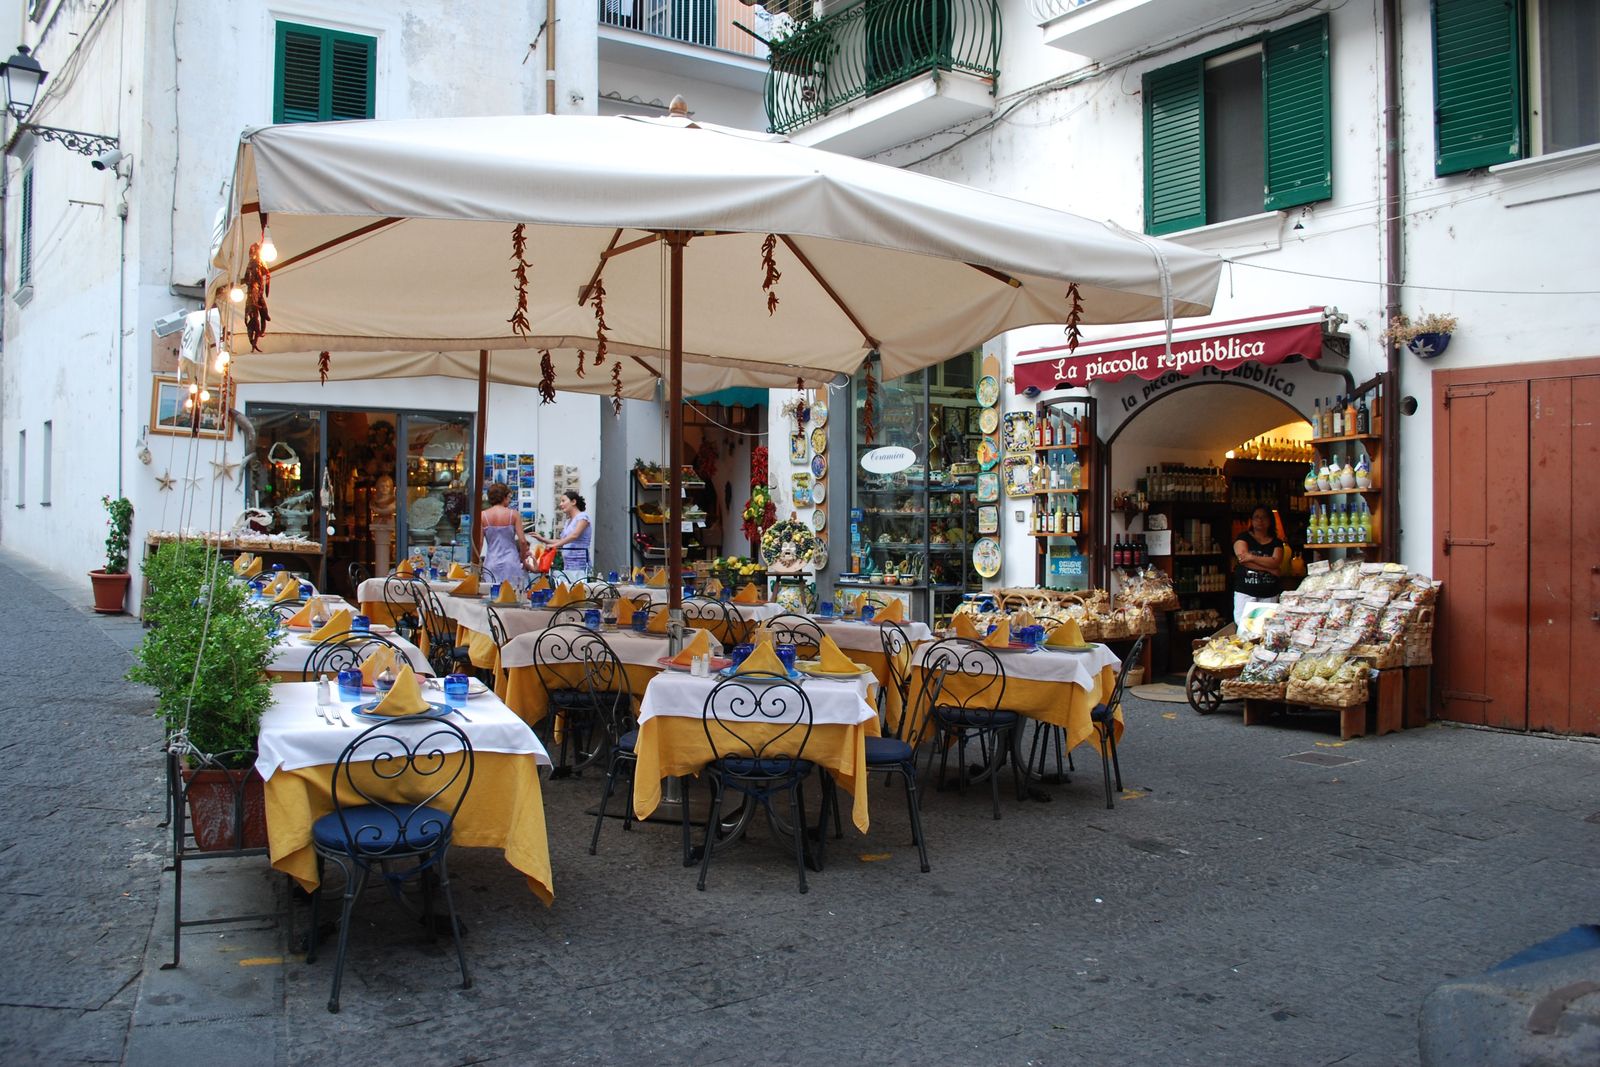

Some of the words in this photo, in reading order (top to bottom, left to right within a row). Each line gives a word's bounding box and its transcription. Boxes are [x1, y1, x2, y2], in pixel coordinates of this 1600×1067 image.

[1051, 358, 1078, 380] La
[1085, 351, 1148, 381] piccola
[1157, 337, 1266, 371] repubblica
[1121, 394, 1138, 412] la
